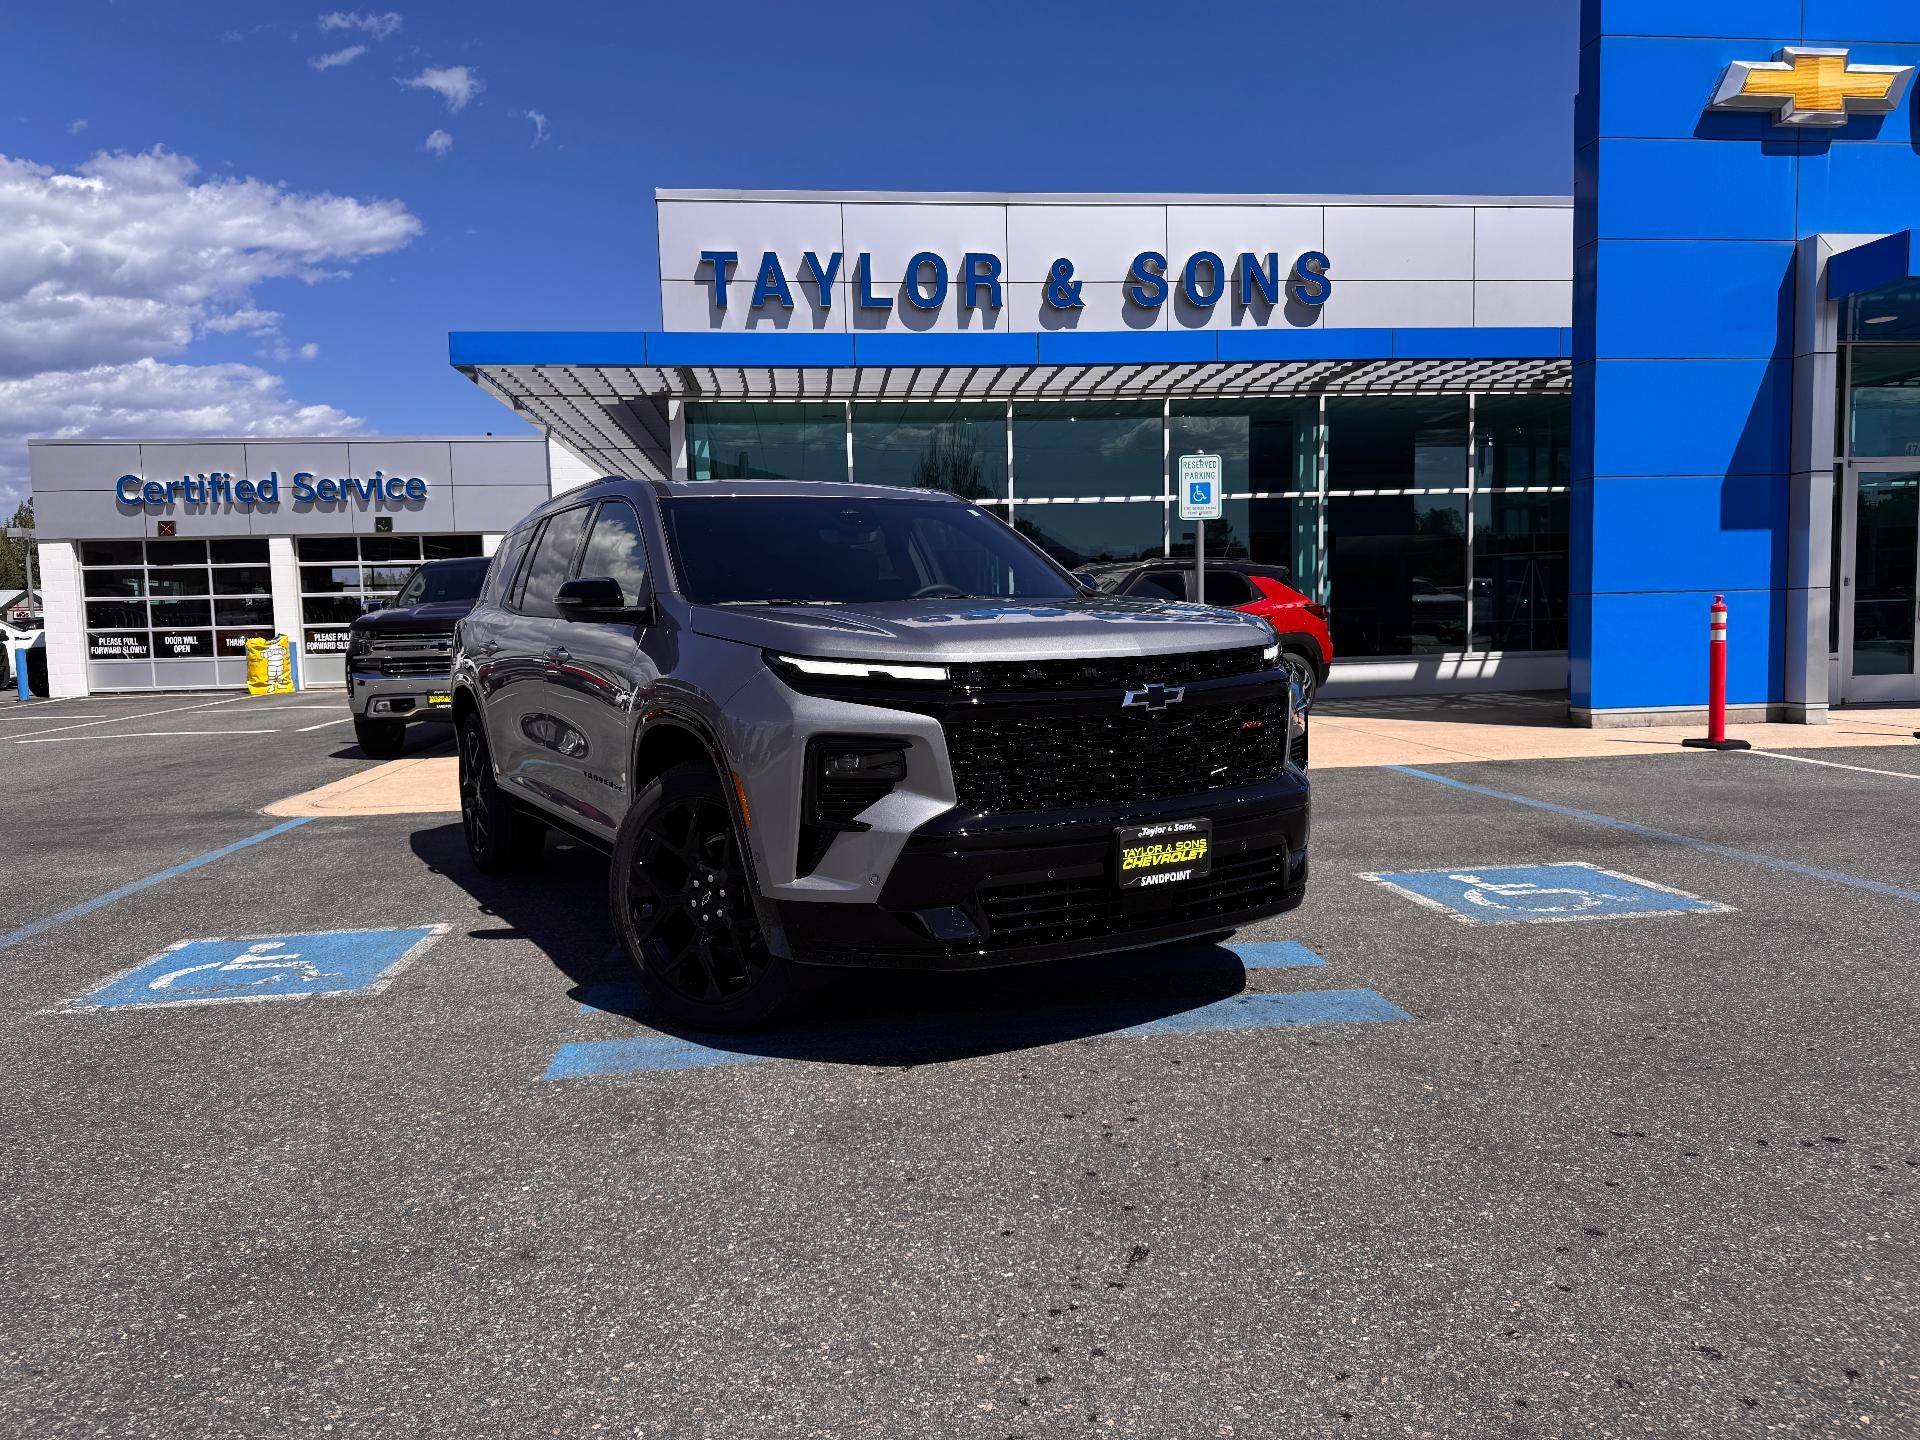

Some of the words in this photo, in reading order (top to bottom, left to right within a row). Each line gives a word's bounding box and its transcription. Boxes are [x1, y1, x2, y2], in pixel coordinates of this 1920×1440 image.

[701, 251, 1003, 309] TAYLOR
[1047, 257, 1085, 309] &
[1131, 250, 1332, 309] SONS
[1183, 461, 1216, 469] RESERVED
[1184, 472, 1215, 480] PARKING
[116, 471, 279, 505] Certified
[293, 471, 427, 503] Service
[98, 637, 122, 646] PLEASE
[123, 637, 138, 646] PULL
[165, 636, 182, 645] DOOR
[183, 636, 198, 644] WILL
[314, 633, 337, 641] PLEASE
[91, 646, 121, 654] FORWARD
[122, 645, 147, 654] SLOWLY
[173, 645, 190, 653] OPEN
[307, 642, 336, 650] FORWARD
[1142, 827, 1166, 837] Taylor
[1174, 824, 1192, 832] Sons
[1123, 845, 1162, 857] TAYLOR
[1165, 844, 1173, 853] &
[1176, 839, 1207, 849] SONS
[1123, 849, 1207, 869] CHEVROLET
[1140, 870, 1191, 886] SANDPOINT
